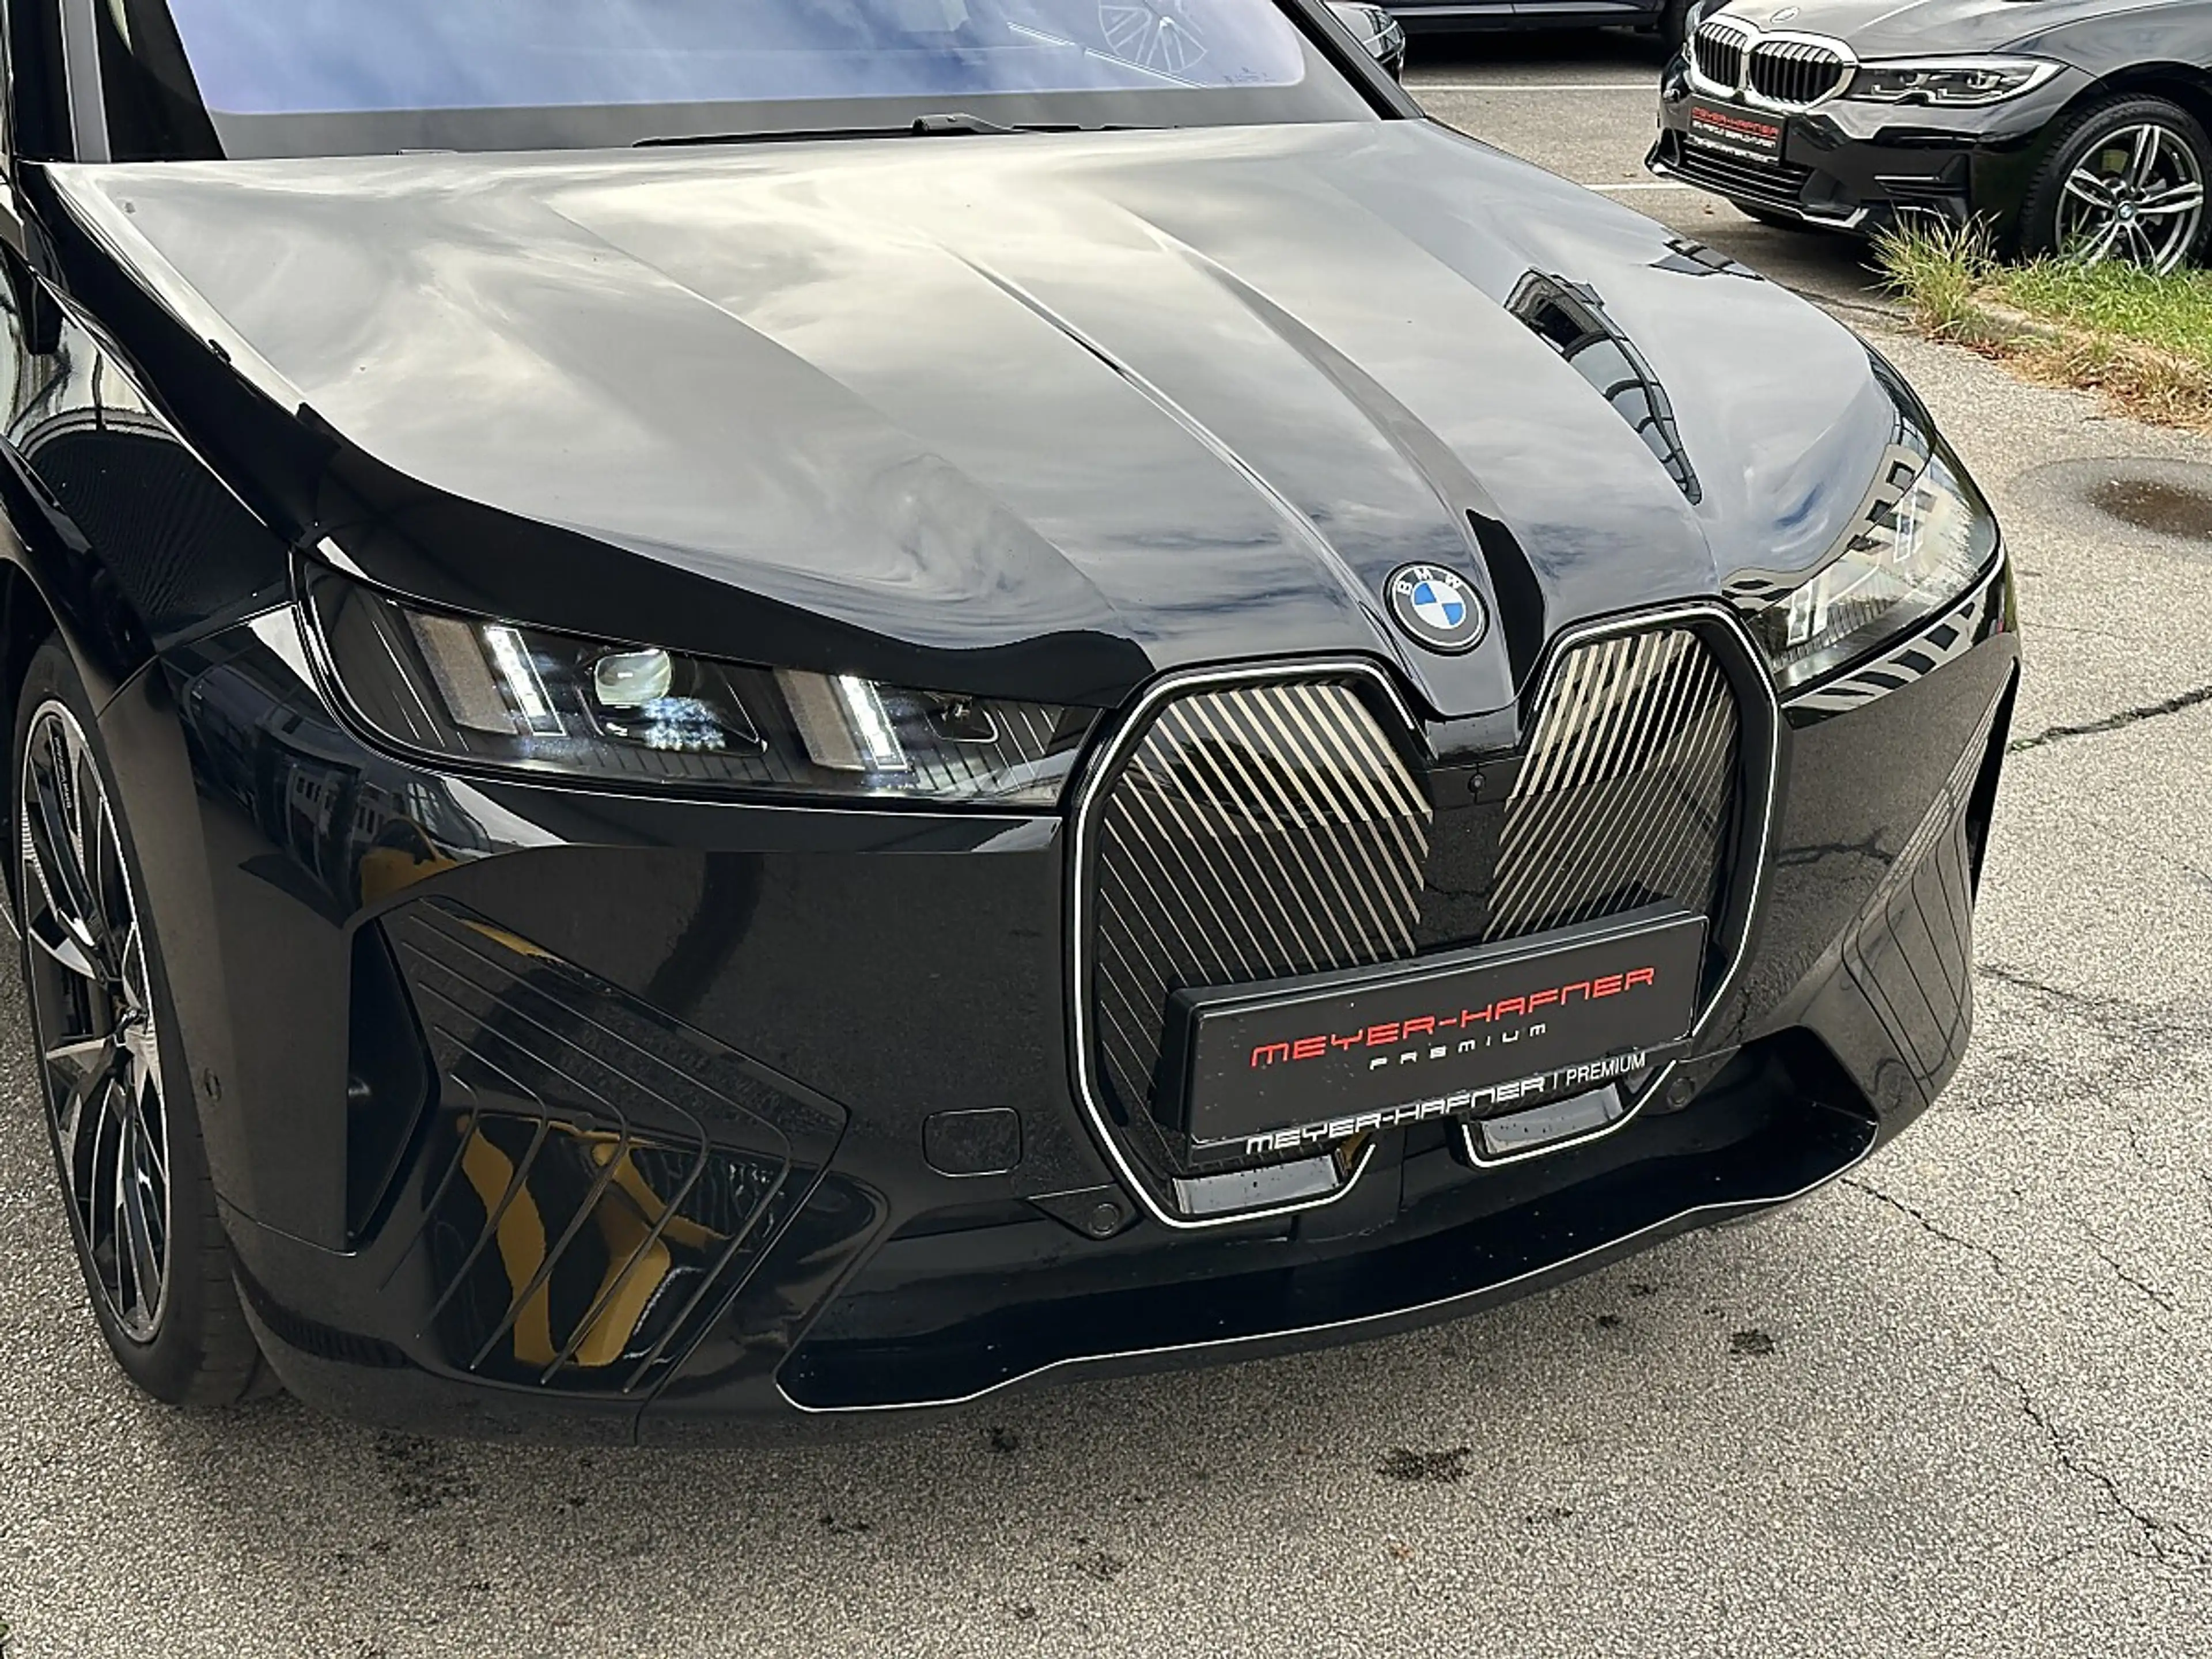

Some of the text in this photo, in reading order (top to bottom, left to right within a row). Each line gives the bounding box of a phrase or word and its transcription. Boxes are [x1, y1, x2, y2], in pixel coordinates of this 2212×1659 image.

[1396, 568, 1461, 594] BMW
[1251, 967, 1654, 1067] MEYER-HAFNER
[1370, 1023, 1546, 1069] PREMIUM
[1247, 1076, 1545, 1155] MEYER-HAFNER
[1566, 1052, 1646, 1087] PREMIUM
